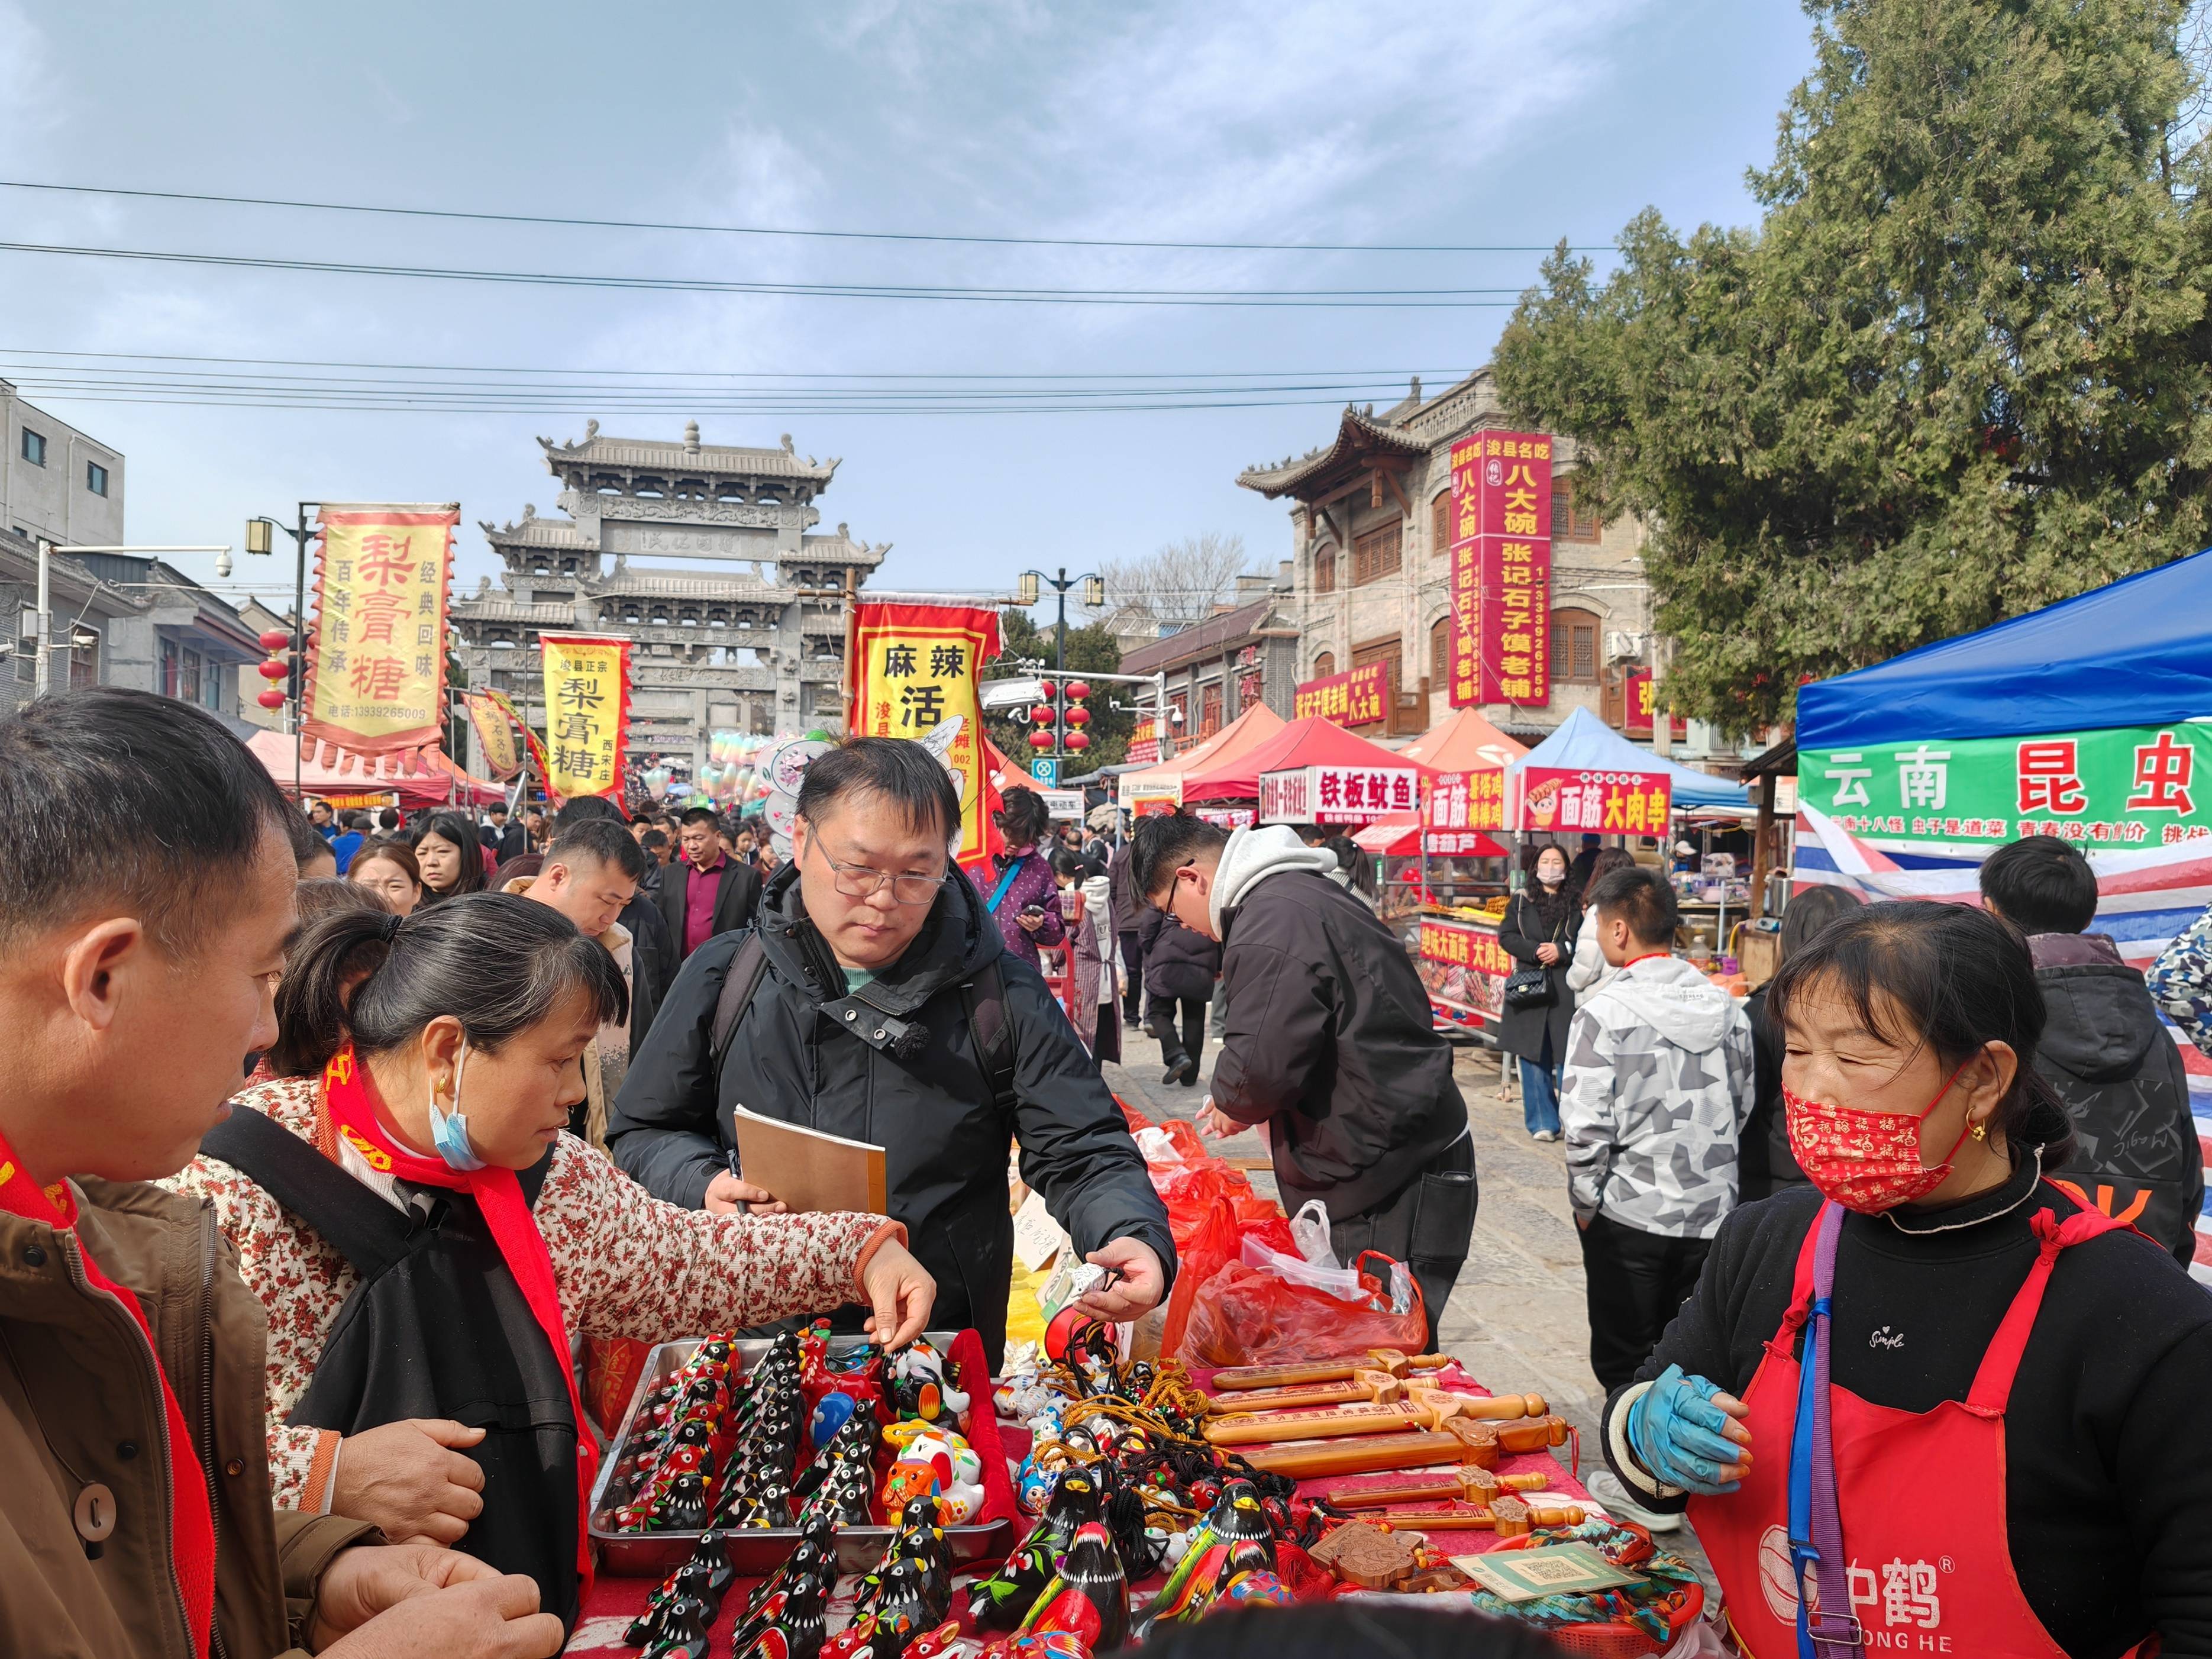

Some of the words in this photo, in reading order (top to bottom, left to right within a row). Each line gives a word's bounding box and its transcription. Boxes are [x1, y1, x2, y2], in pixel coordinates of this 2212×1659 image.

[1486, 440, 1549, 460] 浚县名吃
[1458, 468, 1475, 539] 八大碗
[1504, 464, 1538, 535] 八大碗
[327, 560, 354, 673] 百年传承
[350, 534, 416, 700] 梨膏糖
[415, 560, 437, 677] 经典回味
[1500, 543, 1533, 698] 张记石子馍老铺
[560, 660, 608, 673] 浚县正宗
[884, 644, 965, 678] 麻辣
[551, 678, 605, 779] 梨膏糖
[900, 685, 945, 728] 活
[599, 740, 613, 781] 西宋庄
[1825, 744, 1951, 811] 云南
[2016, 732, 2195, 815] 昆虫
[1319, 772, 1412, 810] 铁板鱿鱼
[1432, 784, 1467, 828] 面筋
[1561, 783, 1668, 832] 面筋大肉串
[1911, 816, 2007, 838] 虫子是道菜
[1869, 1331, 1904, 1350] Simple
[1862, 1629, 1909, 1650] ONG
[1919, 1635, 1953, 1654] HE
